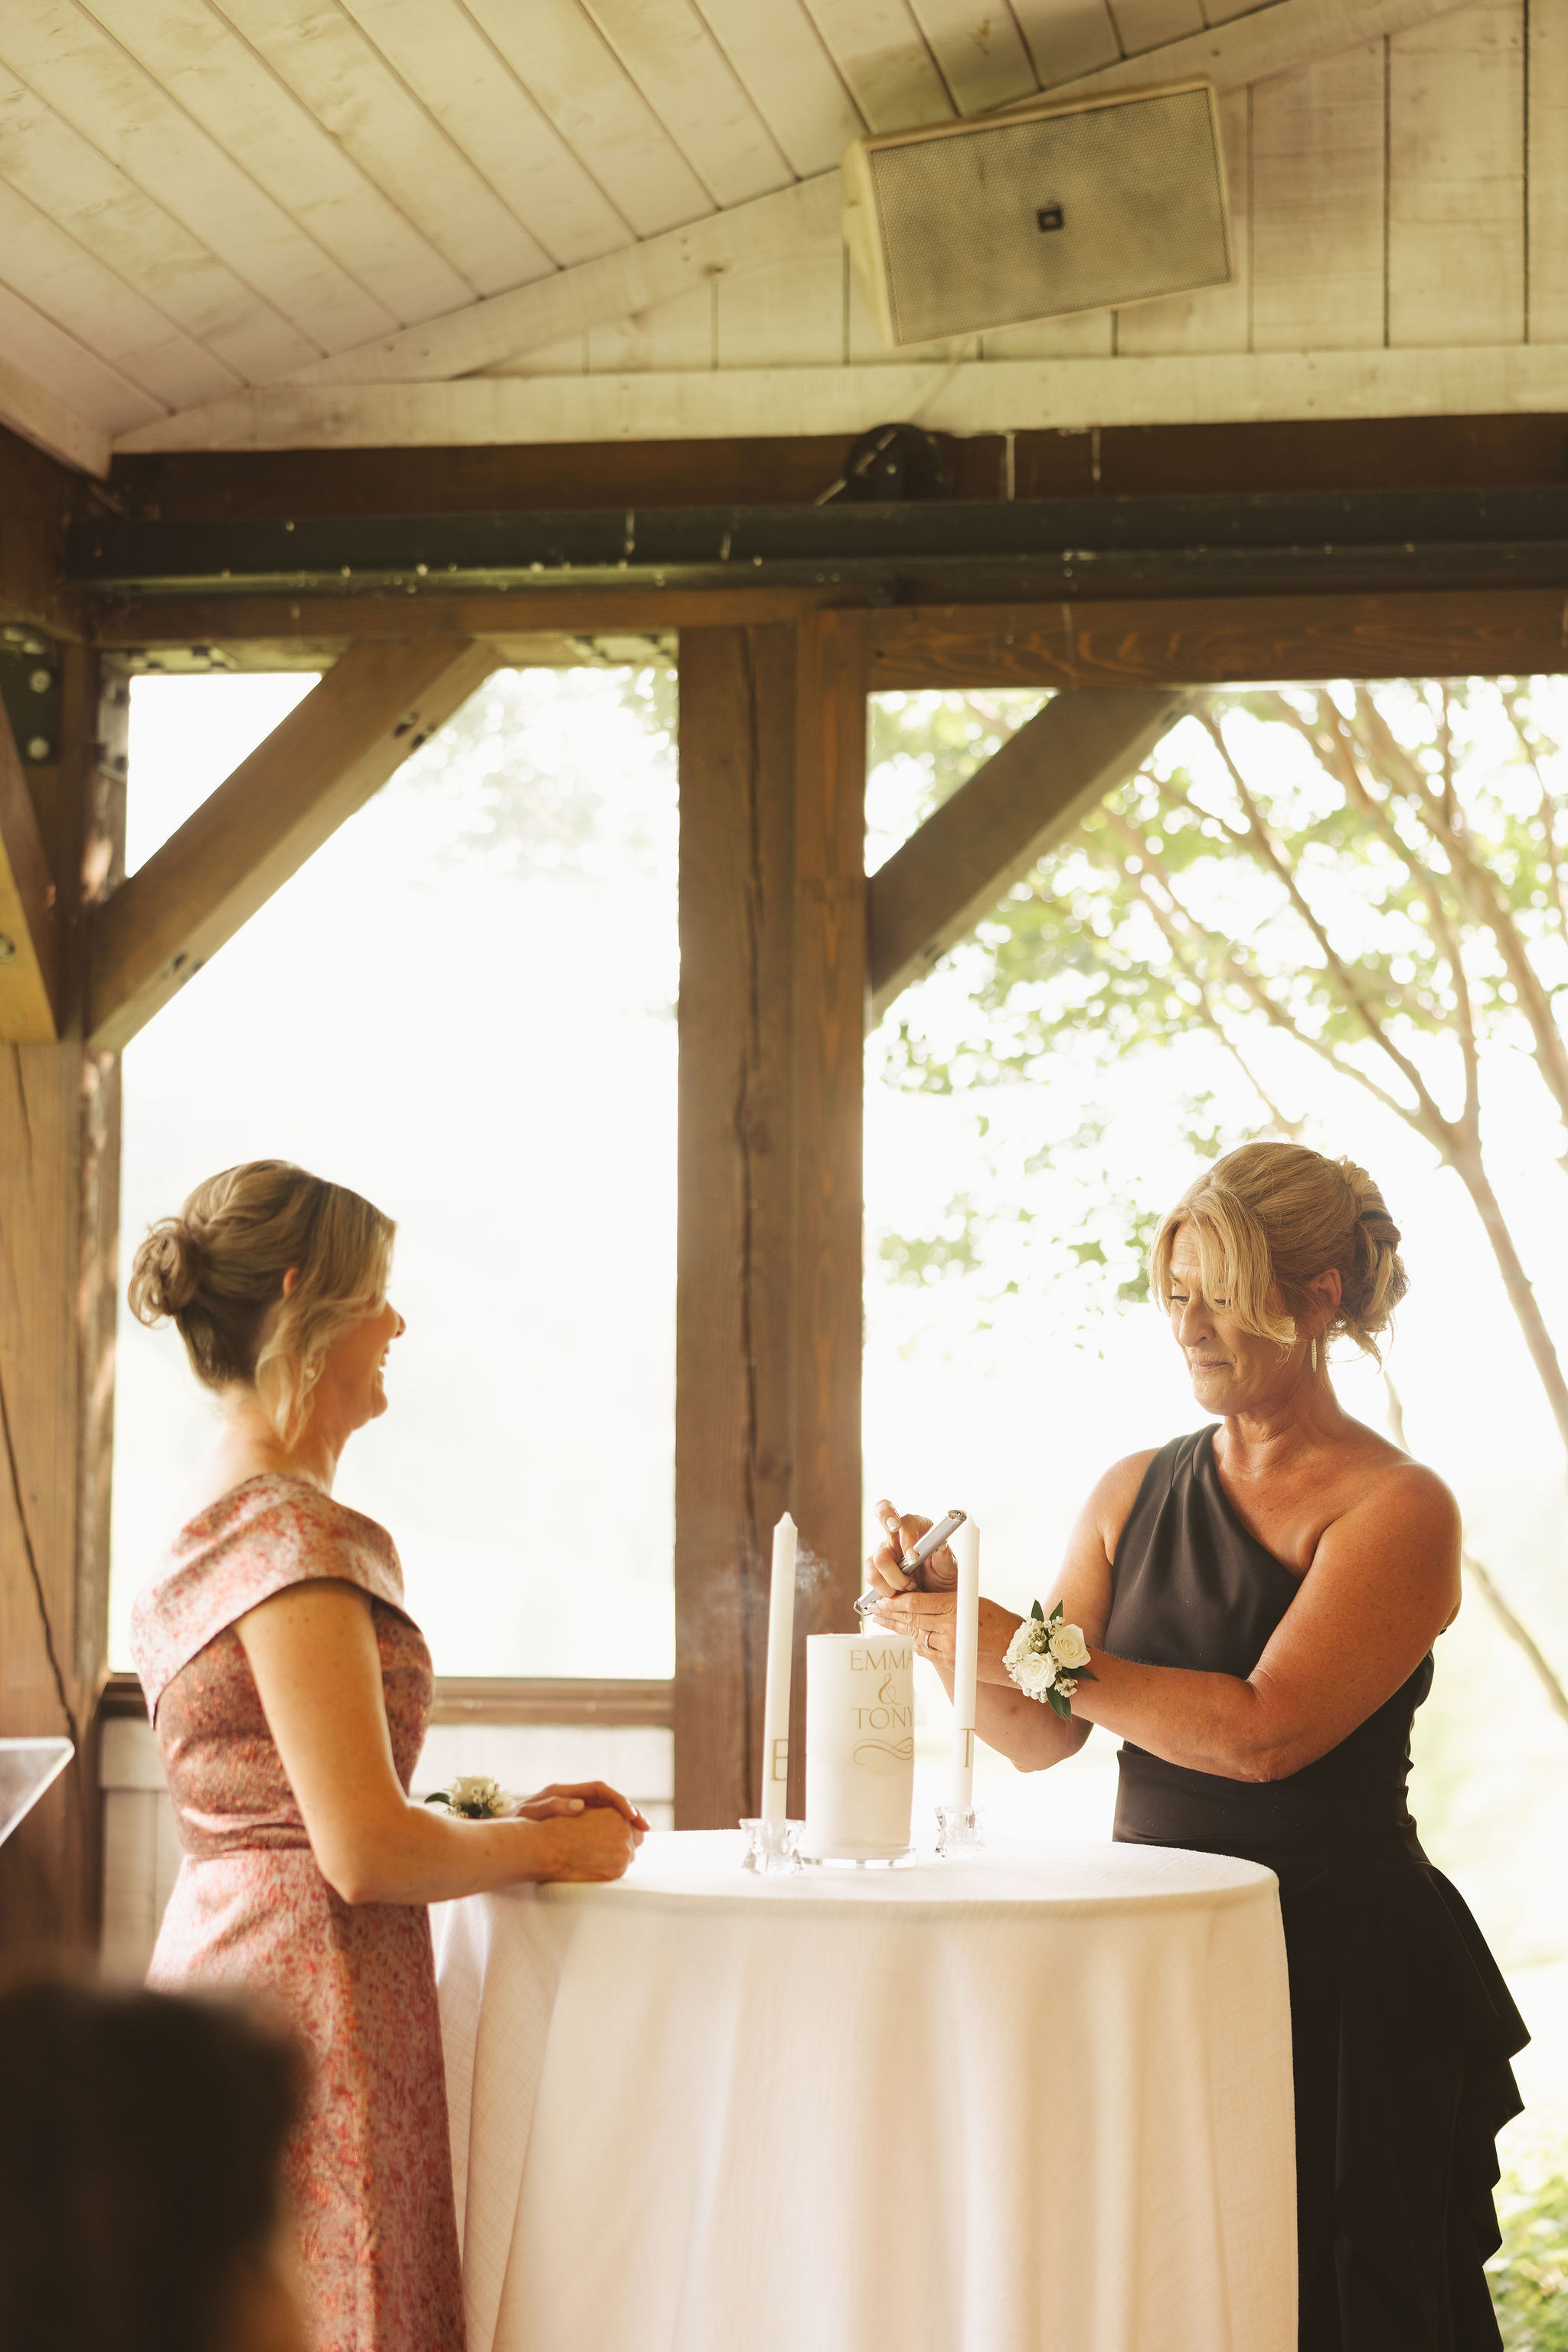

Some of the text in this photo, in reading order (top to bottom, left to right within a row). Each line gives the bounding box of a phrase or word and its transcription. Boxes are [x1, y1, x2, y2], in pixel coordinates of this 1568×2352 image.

[878, 1673, 900, 1706] &
[851, 1707, 913, 1730] TONY
[769, 1737, 789, 1782] E
[959, 1728, 975, 1768] T
